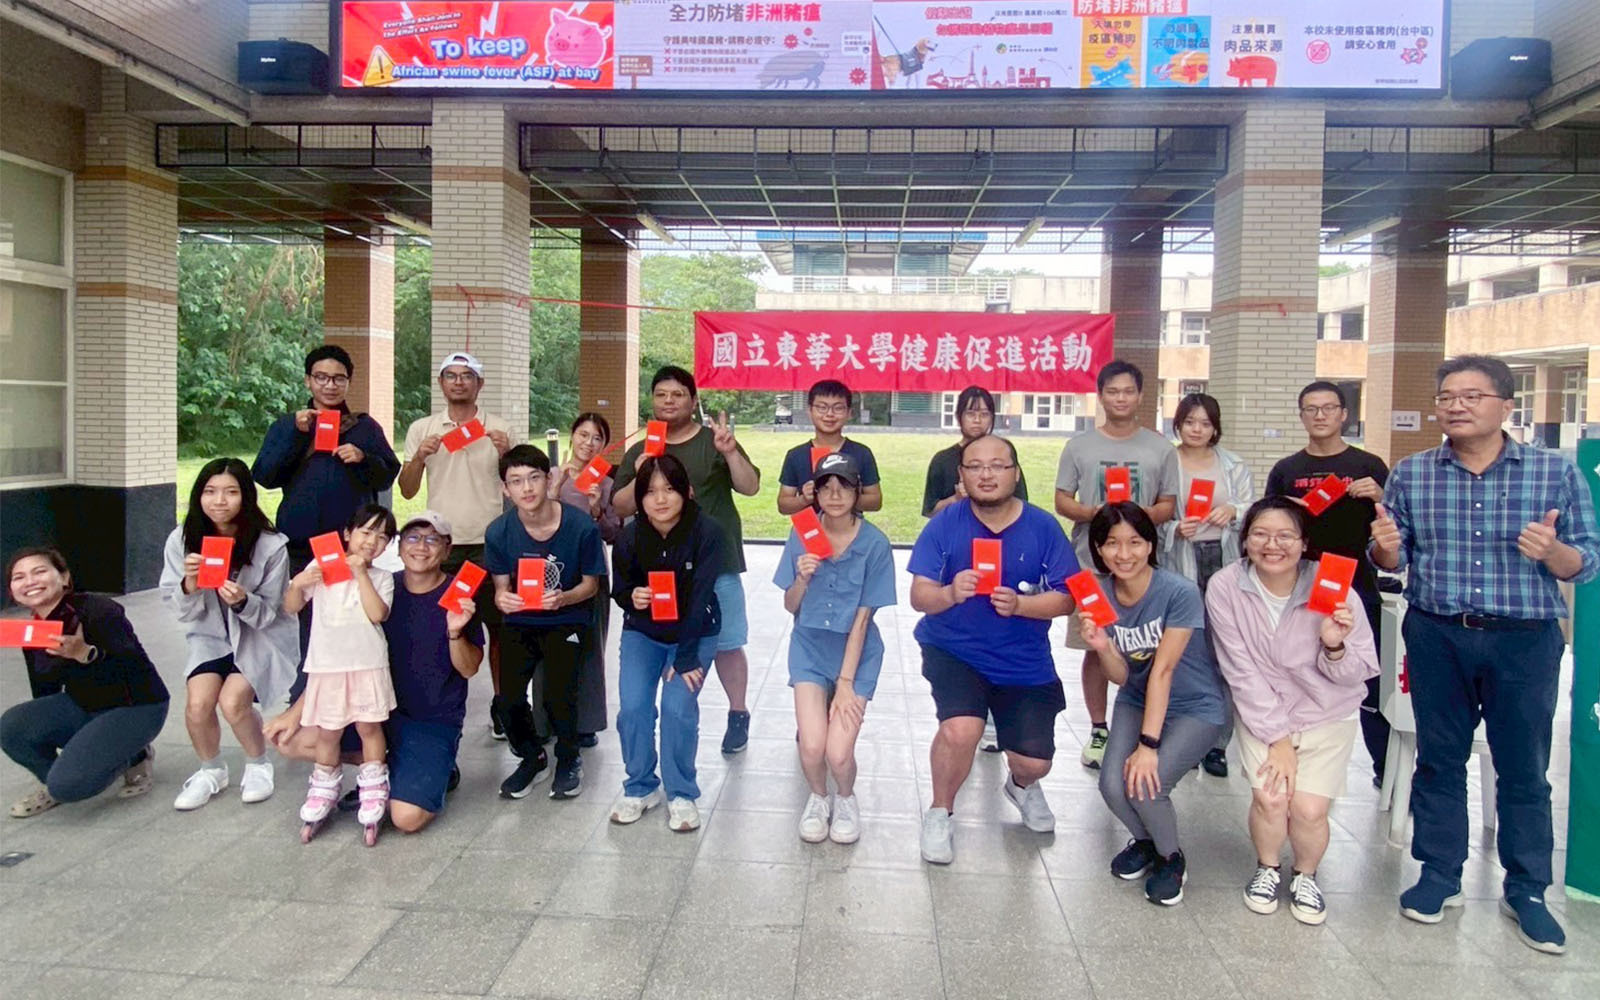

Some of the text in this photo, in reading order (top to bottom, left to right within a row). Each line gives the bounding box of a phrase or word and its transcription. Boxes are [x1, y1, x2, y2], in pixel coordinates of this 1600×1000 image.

[670, 4, 822, 22] 全力防堵非洲豬瘟
[431, 36, 527, 60] To keep
[1224, 40, 1283, 53] 肉品來源
[1344, 40, 1396, 50] 請安心食用
[392, 65, 600, 82] African swine fever (ASF) at bay
[712, 331, 1092, 372] 國立東華大學健康促進活動
